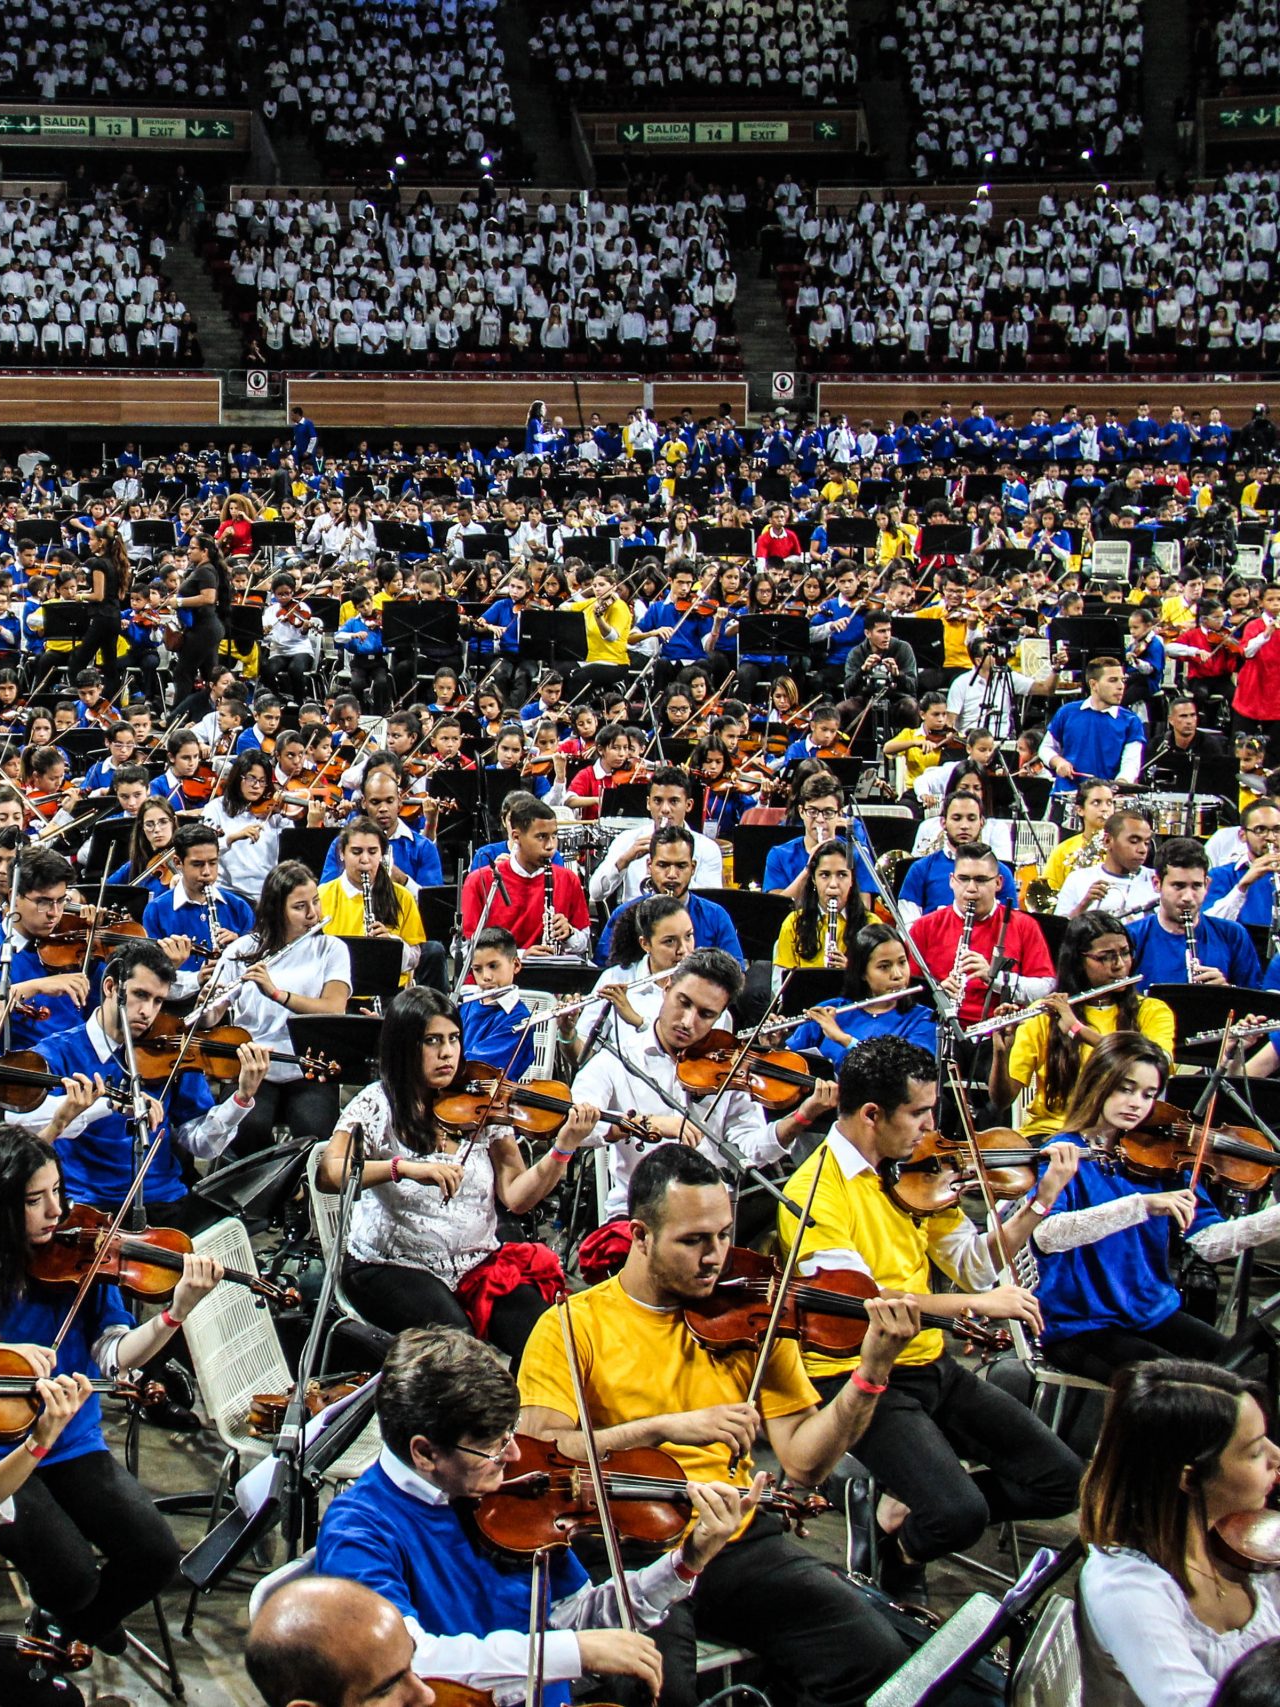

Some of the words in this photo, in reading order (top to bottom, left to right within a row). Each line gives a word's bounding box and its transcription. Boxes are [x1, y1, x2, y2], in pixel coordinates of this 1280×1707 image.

[44, 117, 86, 127] SALIDA
[106, 123, 122, 136] 13
[149, 127, 175, 137] EXIT
[647, 124, 689, 134] SALIDA
[707, 129, 722, 141] 14
[750, 130, 776, 141] EXIT
